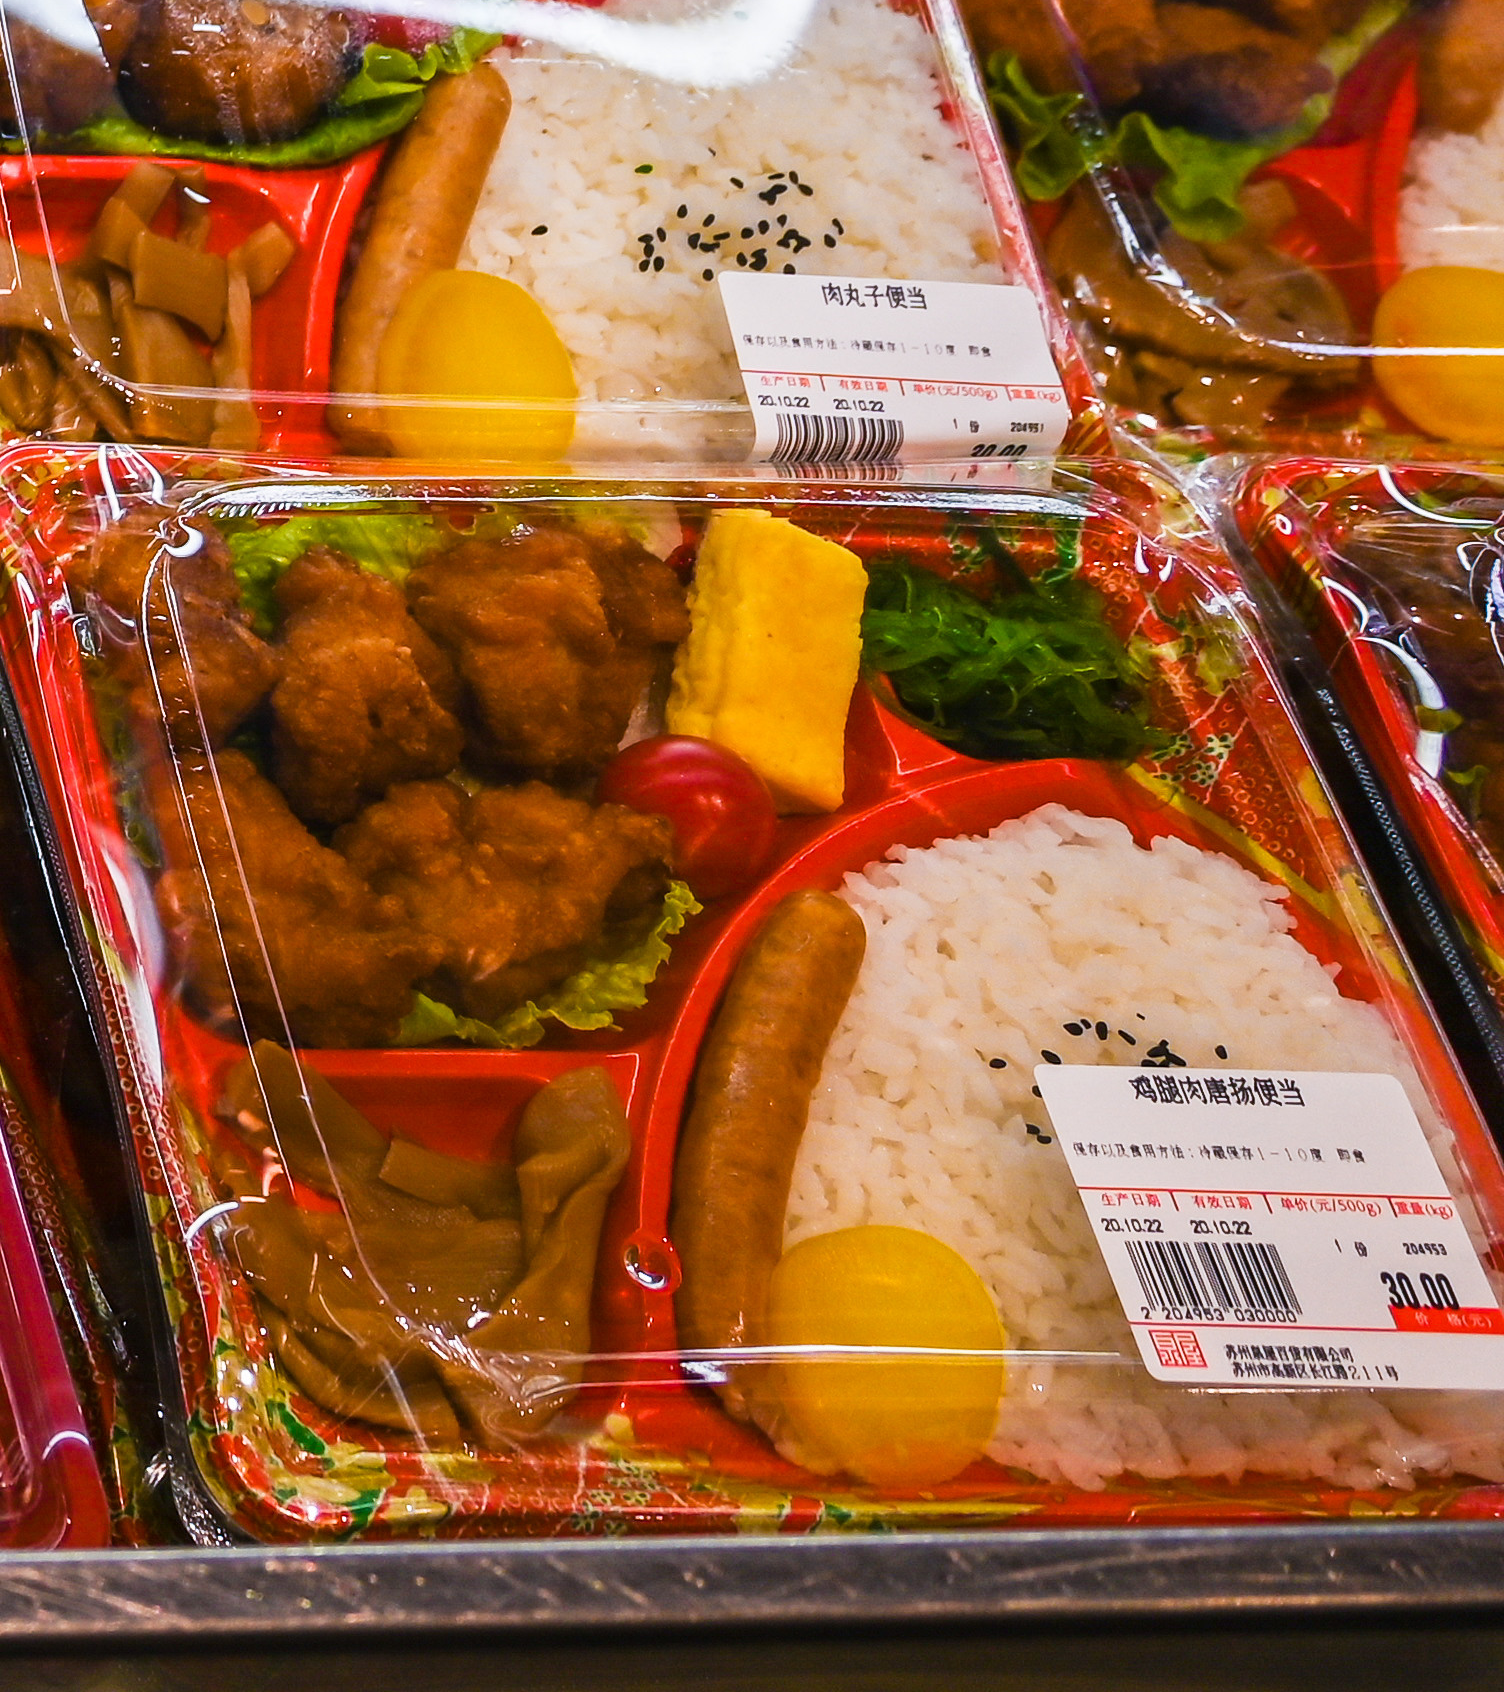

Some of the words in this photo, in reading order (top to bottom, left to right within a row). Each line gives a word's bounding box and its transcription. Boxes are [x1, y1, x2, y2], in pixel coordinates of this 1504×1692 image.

[821, 284, 927, 310] 肉丸子便当
[758, 395, 810, 409] 20.10.22
[833, 398, 885, 413] 20.10.22
[1128, 1074, 1306, 1108] 鸡腿肉唐扬便当
[1101, 1193, 1162, 1208] 生产日期
[1192, 1194, 1252, 1210] 有效日期
[1101, 1217, 1164, 1234] 20.10.22
[1190, 1219, 1252, 1236] 20.10.22
[1403, 1242, 1448, 1256] 204953
[1381, 1271, 1459, 1310] 30.00
